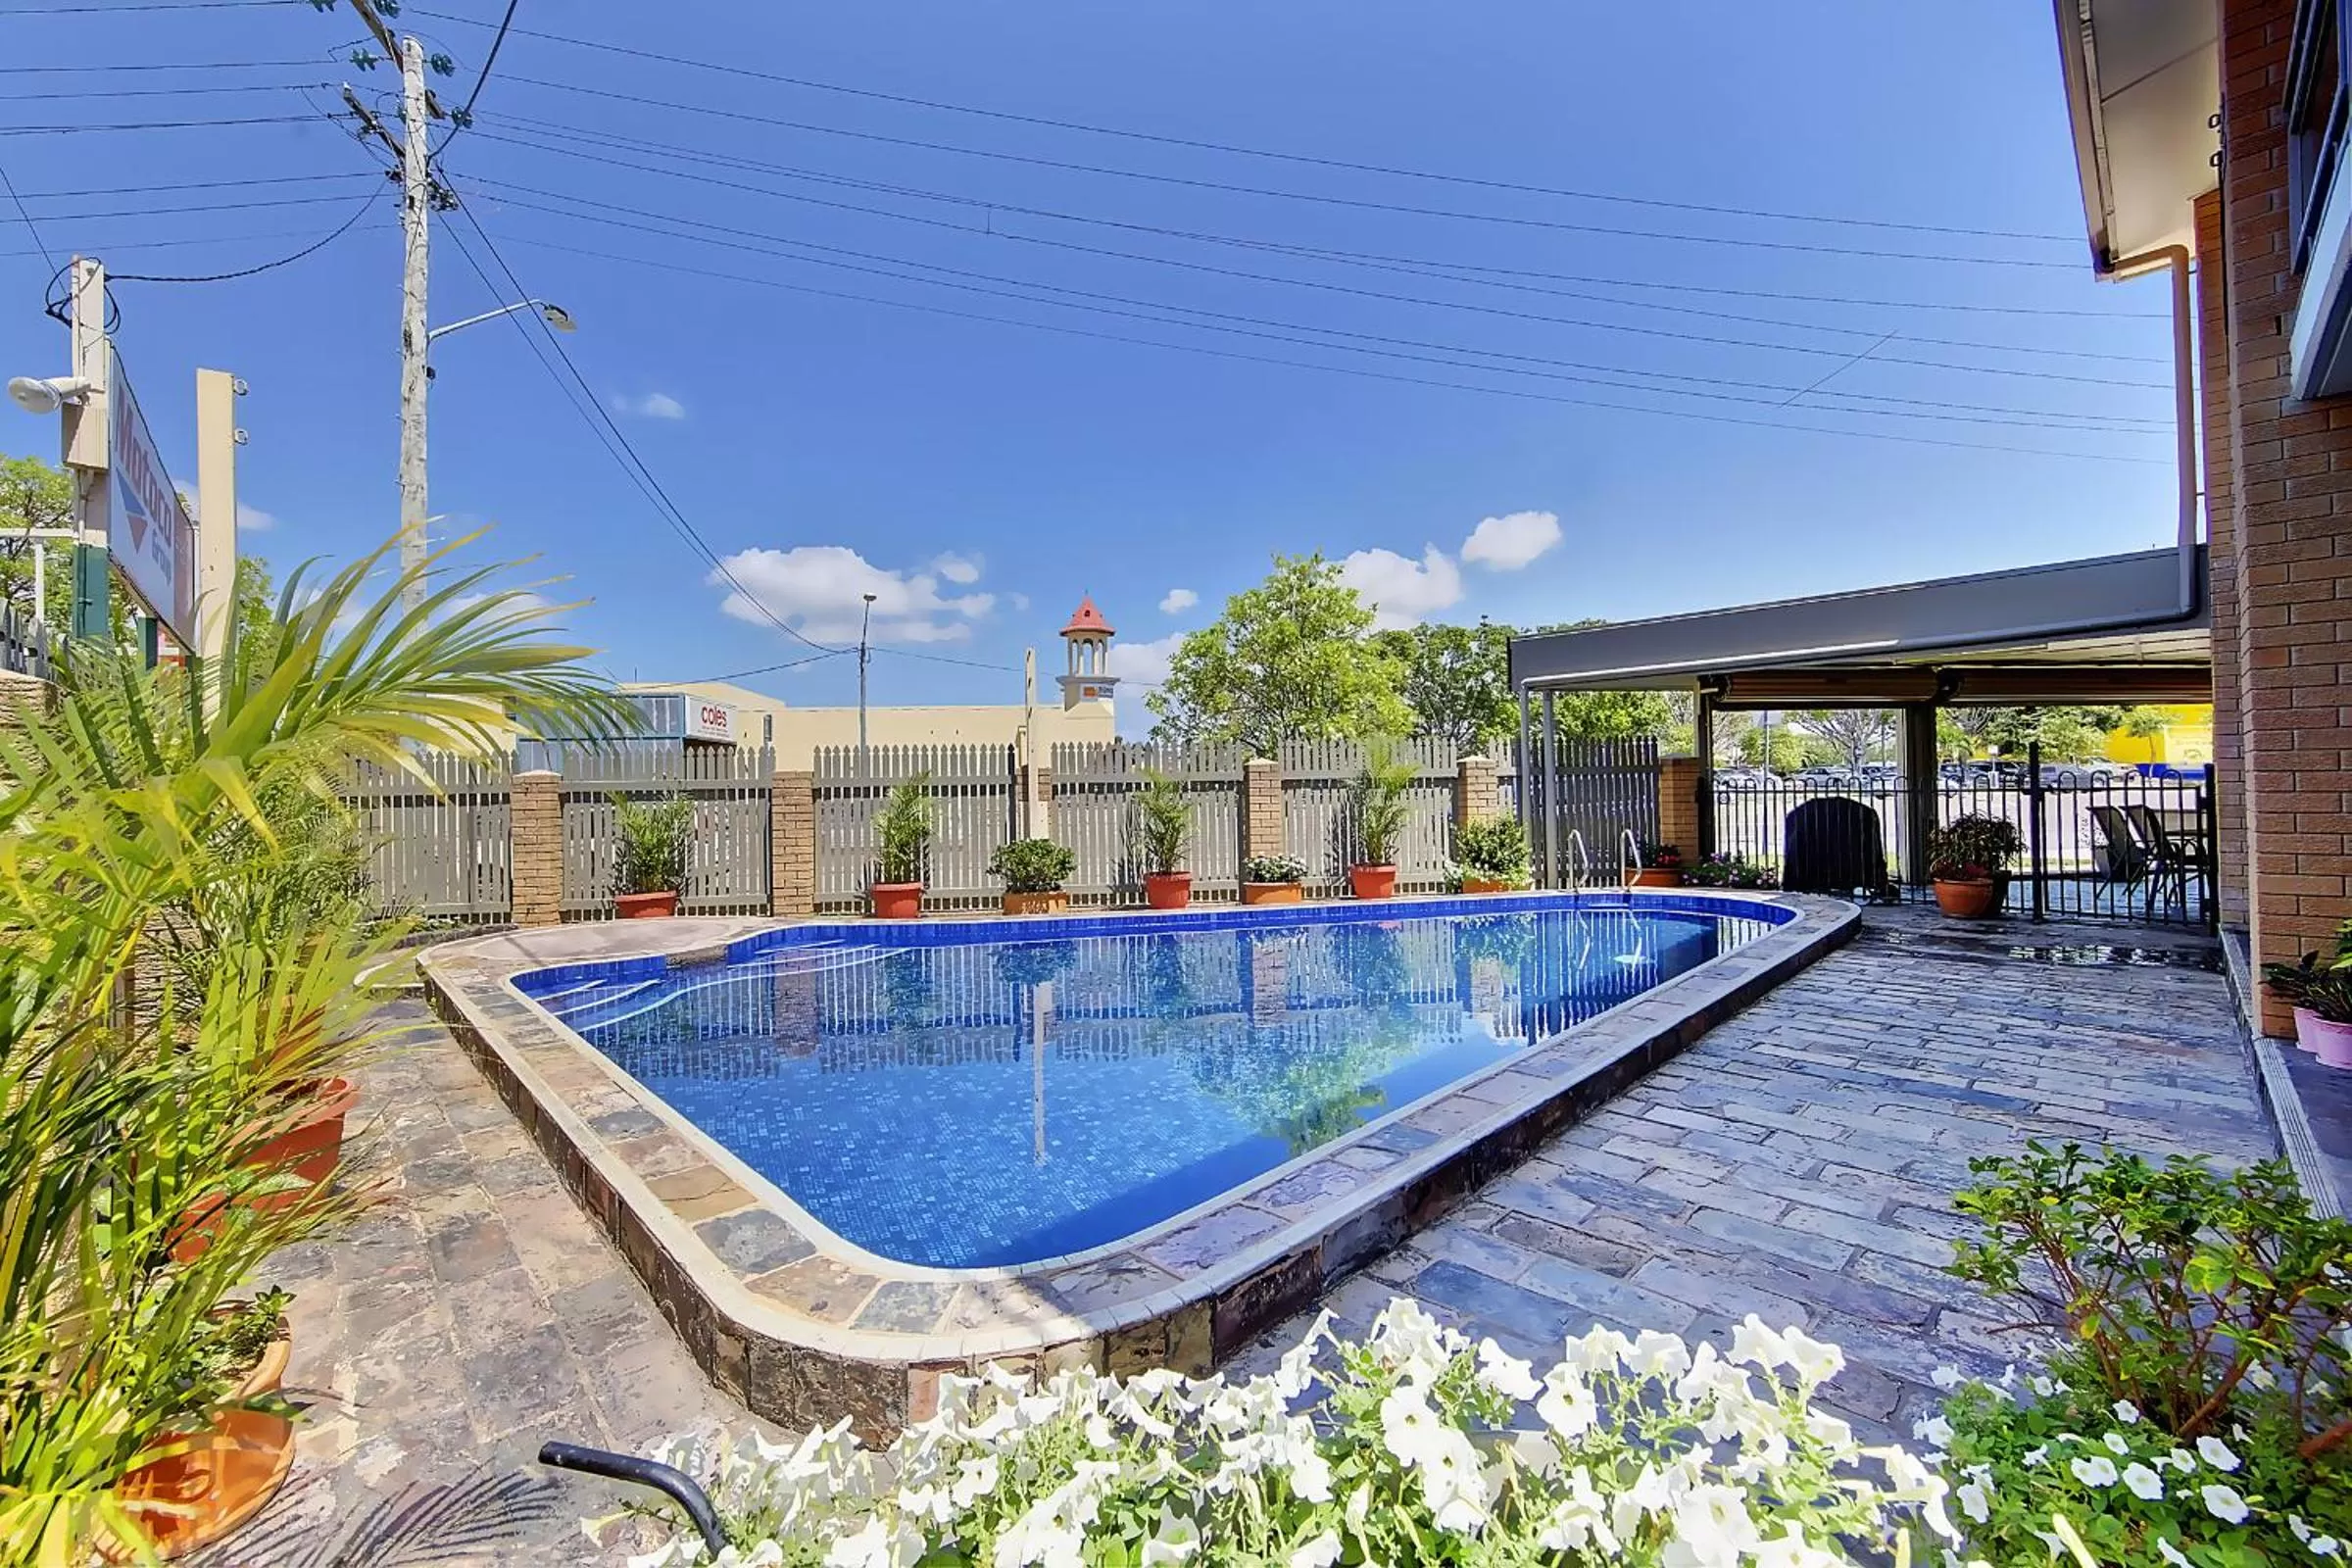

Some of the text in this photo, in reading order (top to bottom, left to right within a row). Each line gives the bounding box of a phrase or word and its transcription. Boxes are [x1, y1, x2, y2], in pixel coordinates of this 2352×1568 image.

[115, 384, 172, 548] Motoco
[152, 528, 172, 586] Group
[701, 705, 727, 727] coles
